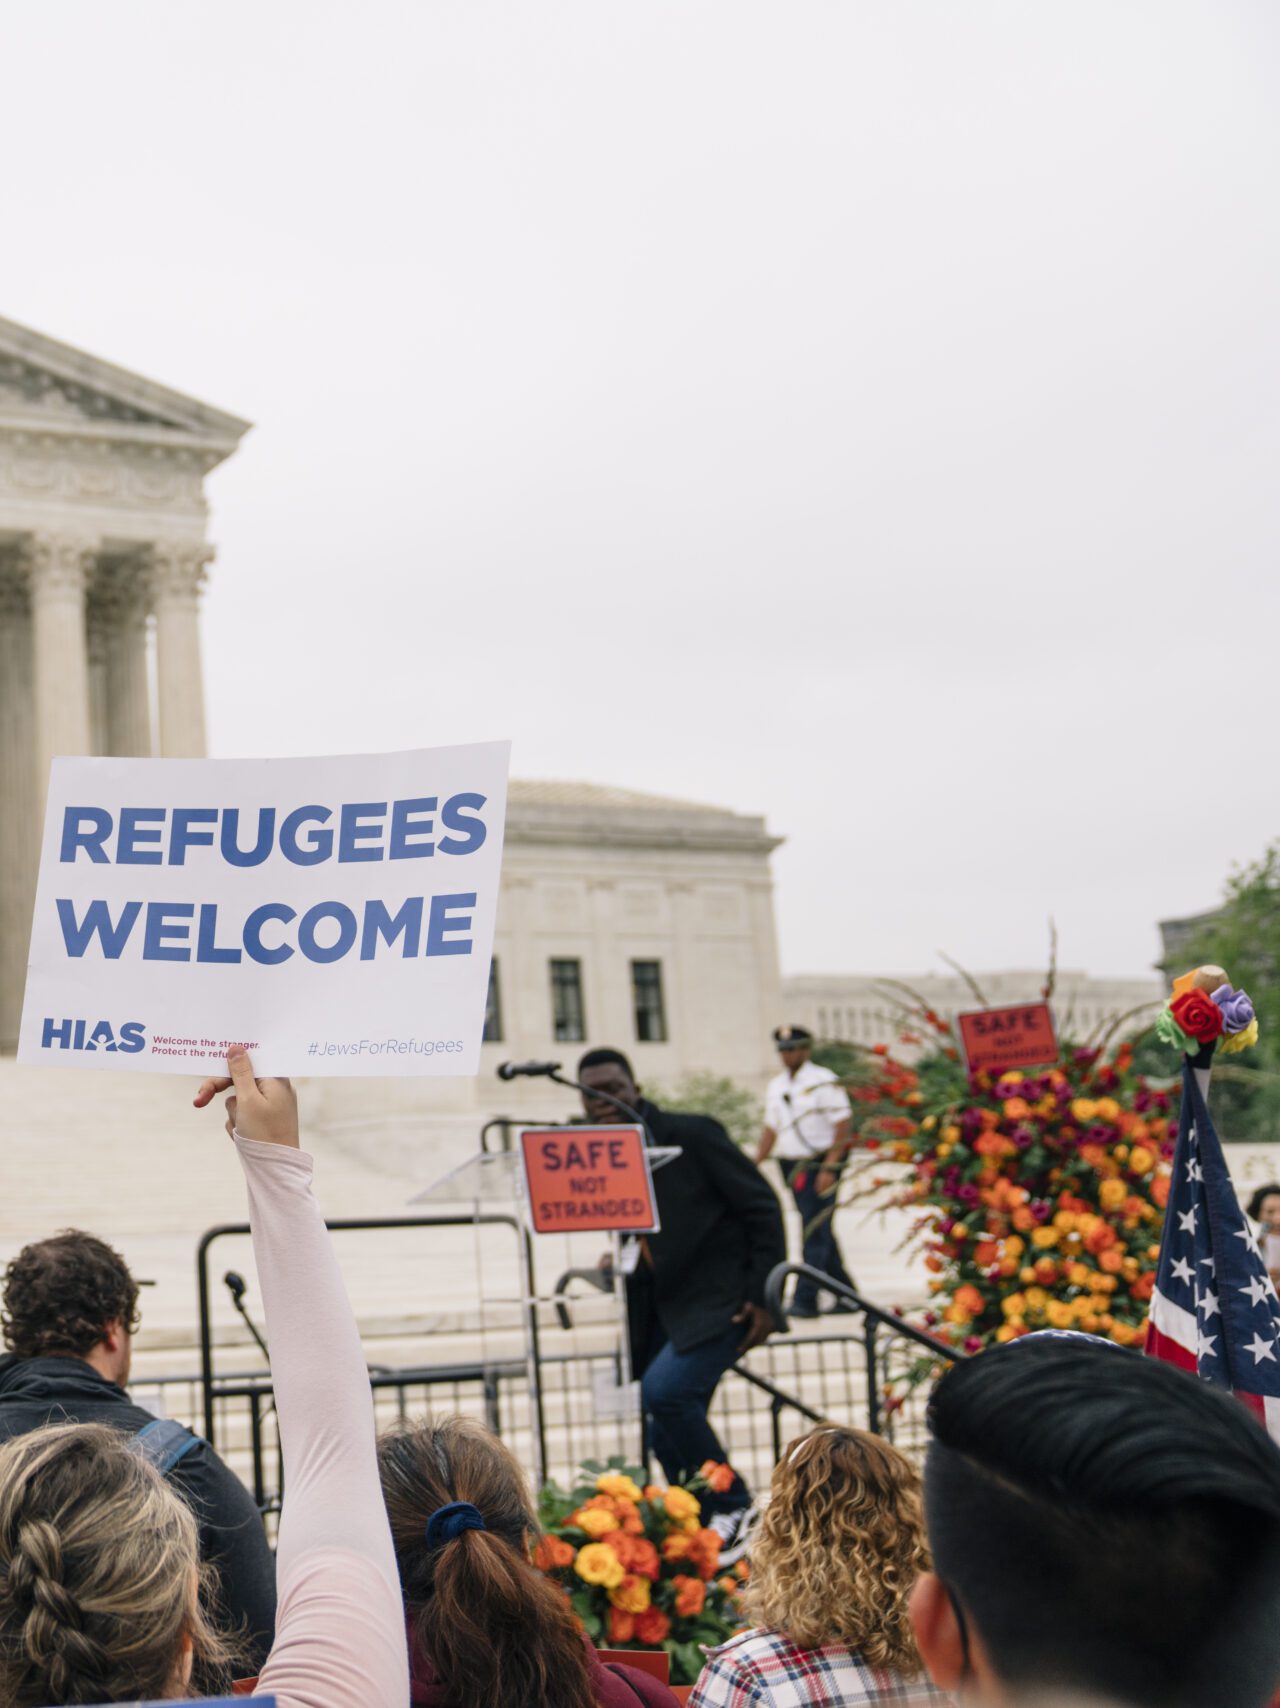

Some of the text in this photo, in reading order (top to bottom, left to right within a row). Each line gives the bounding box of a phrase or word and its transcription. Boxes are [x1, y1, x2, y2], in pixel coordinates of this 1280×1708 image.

[60, 793, 488, 867] REFUGEES
[56, 892, 477, 965] WELCOME
[973, 1009, 1039, 1036] SAFE
[41, 1018, 146, 1054] HIAS
[153, 1036, 197, 1046] Welcome
[200, 1039, 216, 1047] the
[307, 1039, 465, 1056] #JewsForRefugees
[152, 1046, 187, 1056] Protect
[190, 1049, 206, 1057] the
[541, 1140, 629, 1171] SAFE
[569, 1176, 608, 1195] NOT
[539, 1198, 645, 1221] STRANDED
